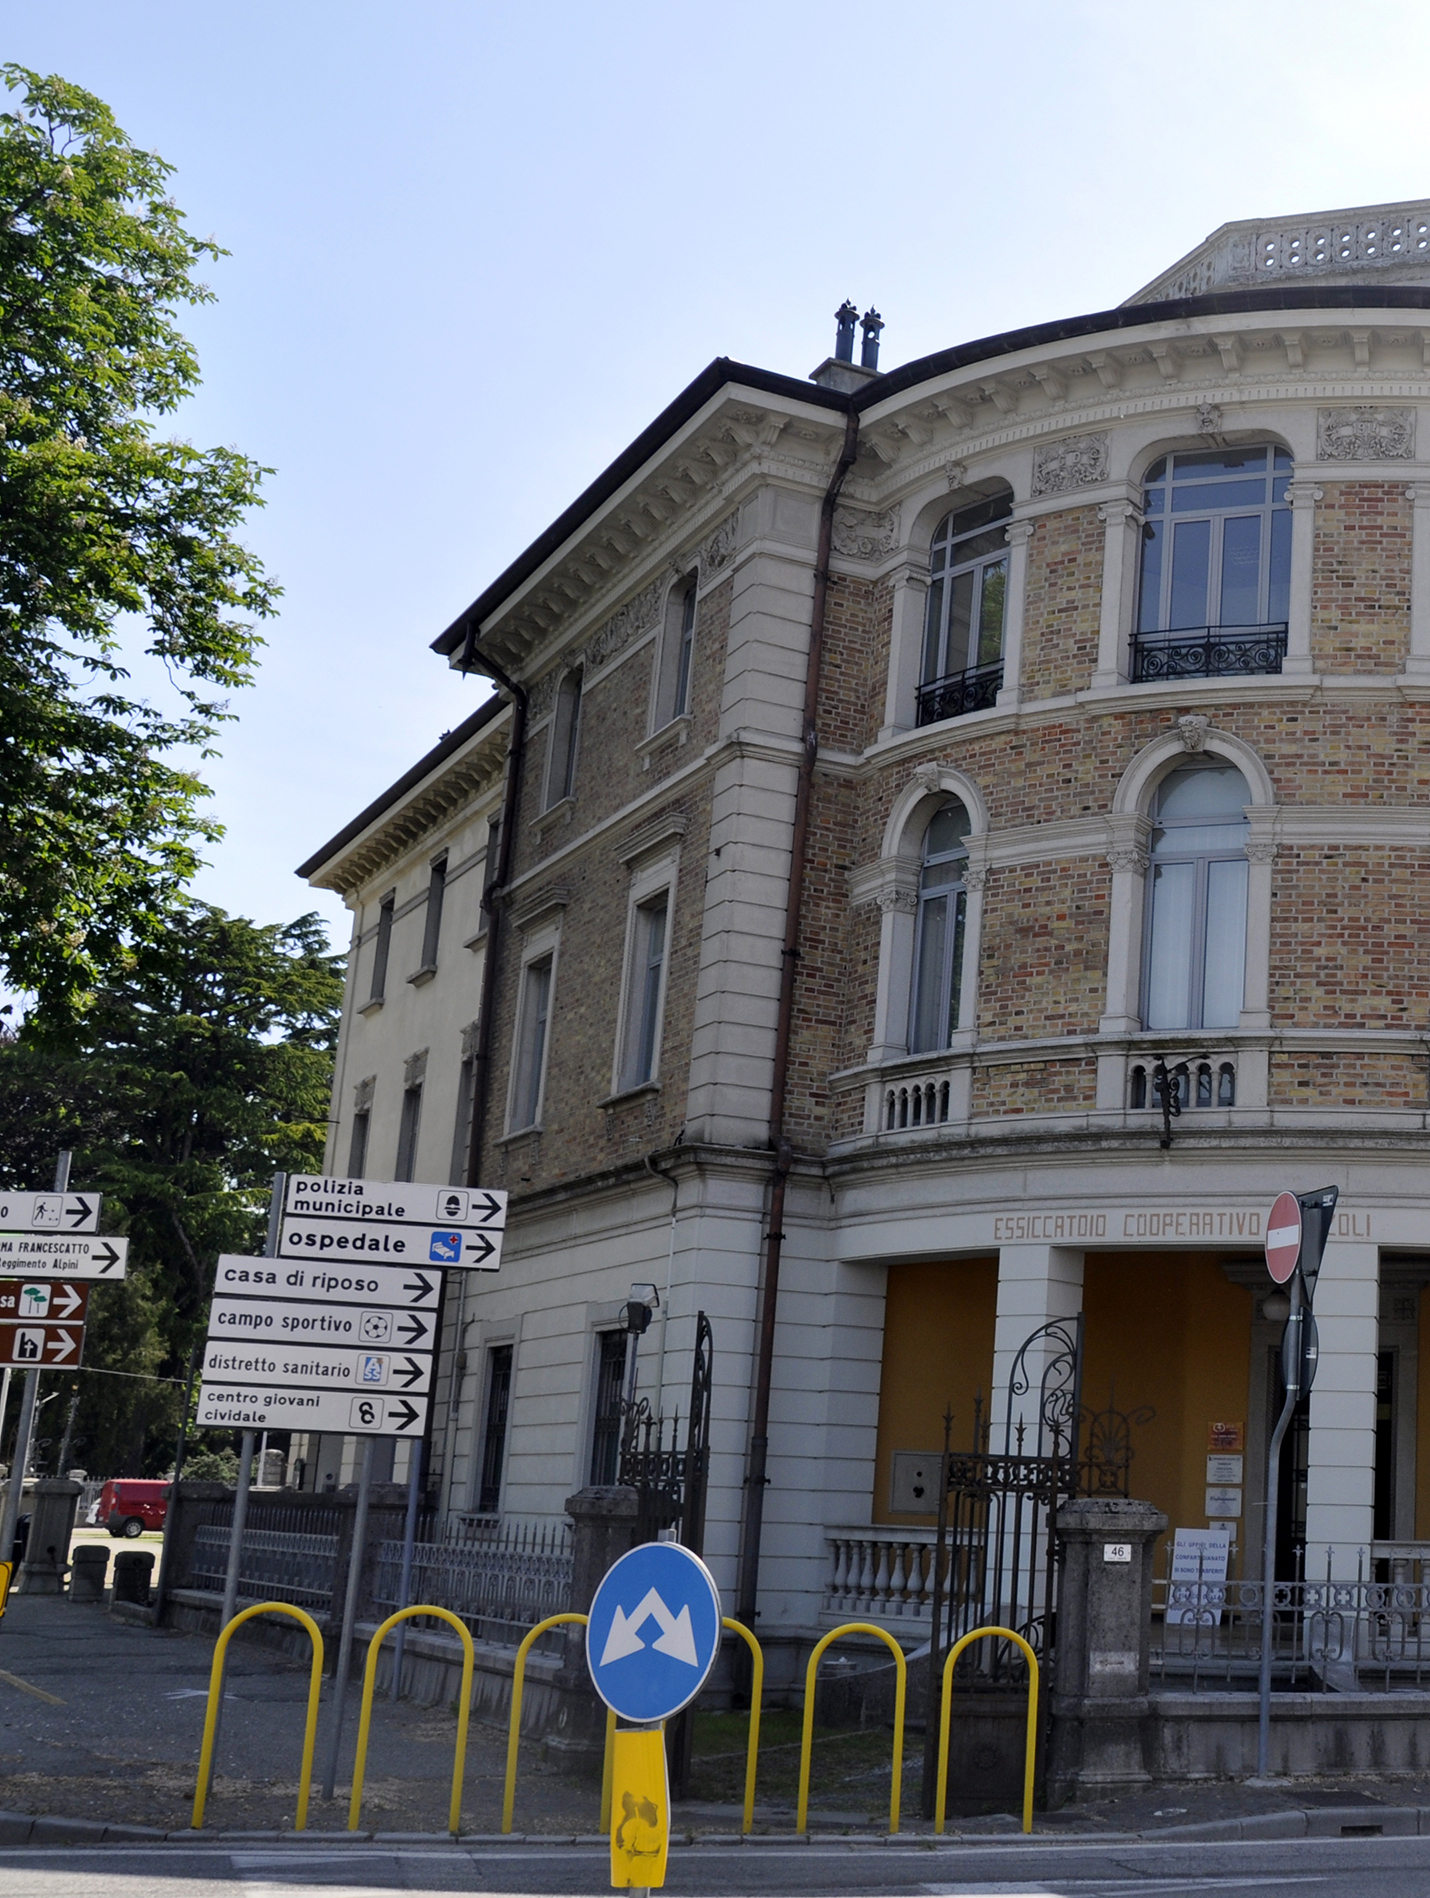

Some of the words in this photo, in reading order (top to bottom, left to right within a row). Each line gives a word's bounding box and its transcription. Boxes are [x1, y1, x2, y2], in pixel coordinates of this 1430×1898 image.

[296, 1180, 364, 1195] polizia
[294, 1199, 405, 1217] municipale
[994, 1214, 1106, 1240] ESSICCATOIO
[18, 1242, 90, 1254] FRANCESCATTO
[288, 1232, 406, 1253] ospedale
[52, 1258, 79, 1271] Alpini
[224, 1268, 277, 1285] casa
[286, 1270, 304, 1287] di
[312, 1273, 379, 1293] riposo
[218, 1312, 274, 1329] campo
[281, 1315, 352, 1333] sportivo
[208, 1354, 276, 1373] distretto
[282, 1361, 350, 1378] sanitario
[207, 1391, 258, 1404] centro
[263, 1392, 320, 1407] giovani
[204, 1409, 267, 1423] cividale
[1111, 1546, 1125, 1557] 46
